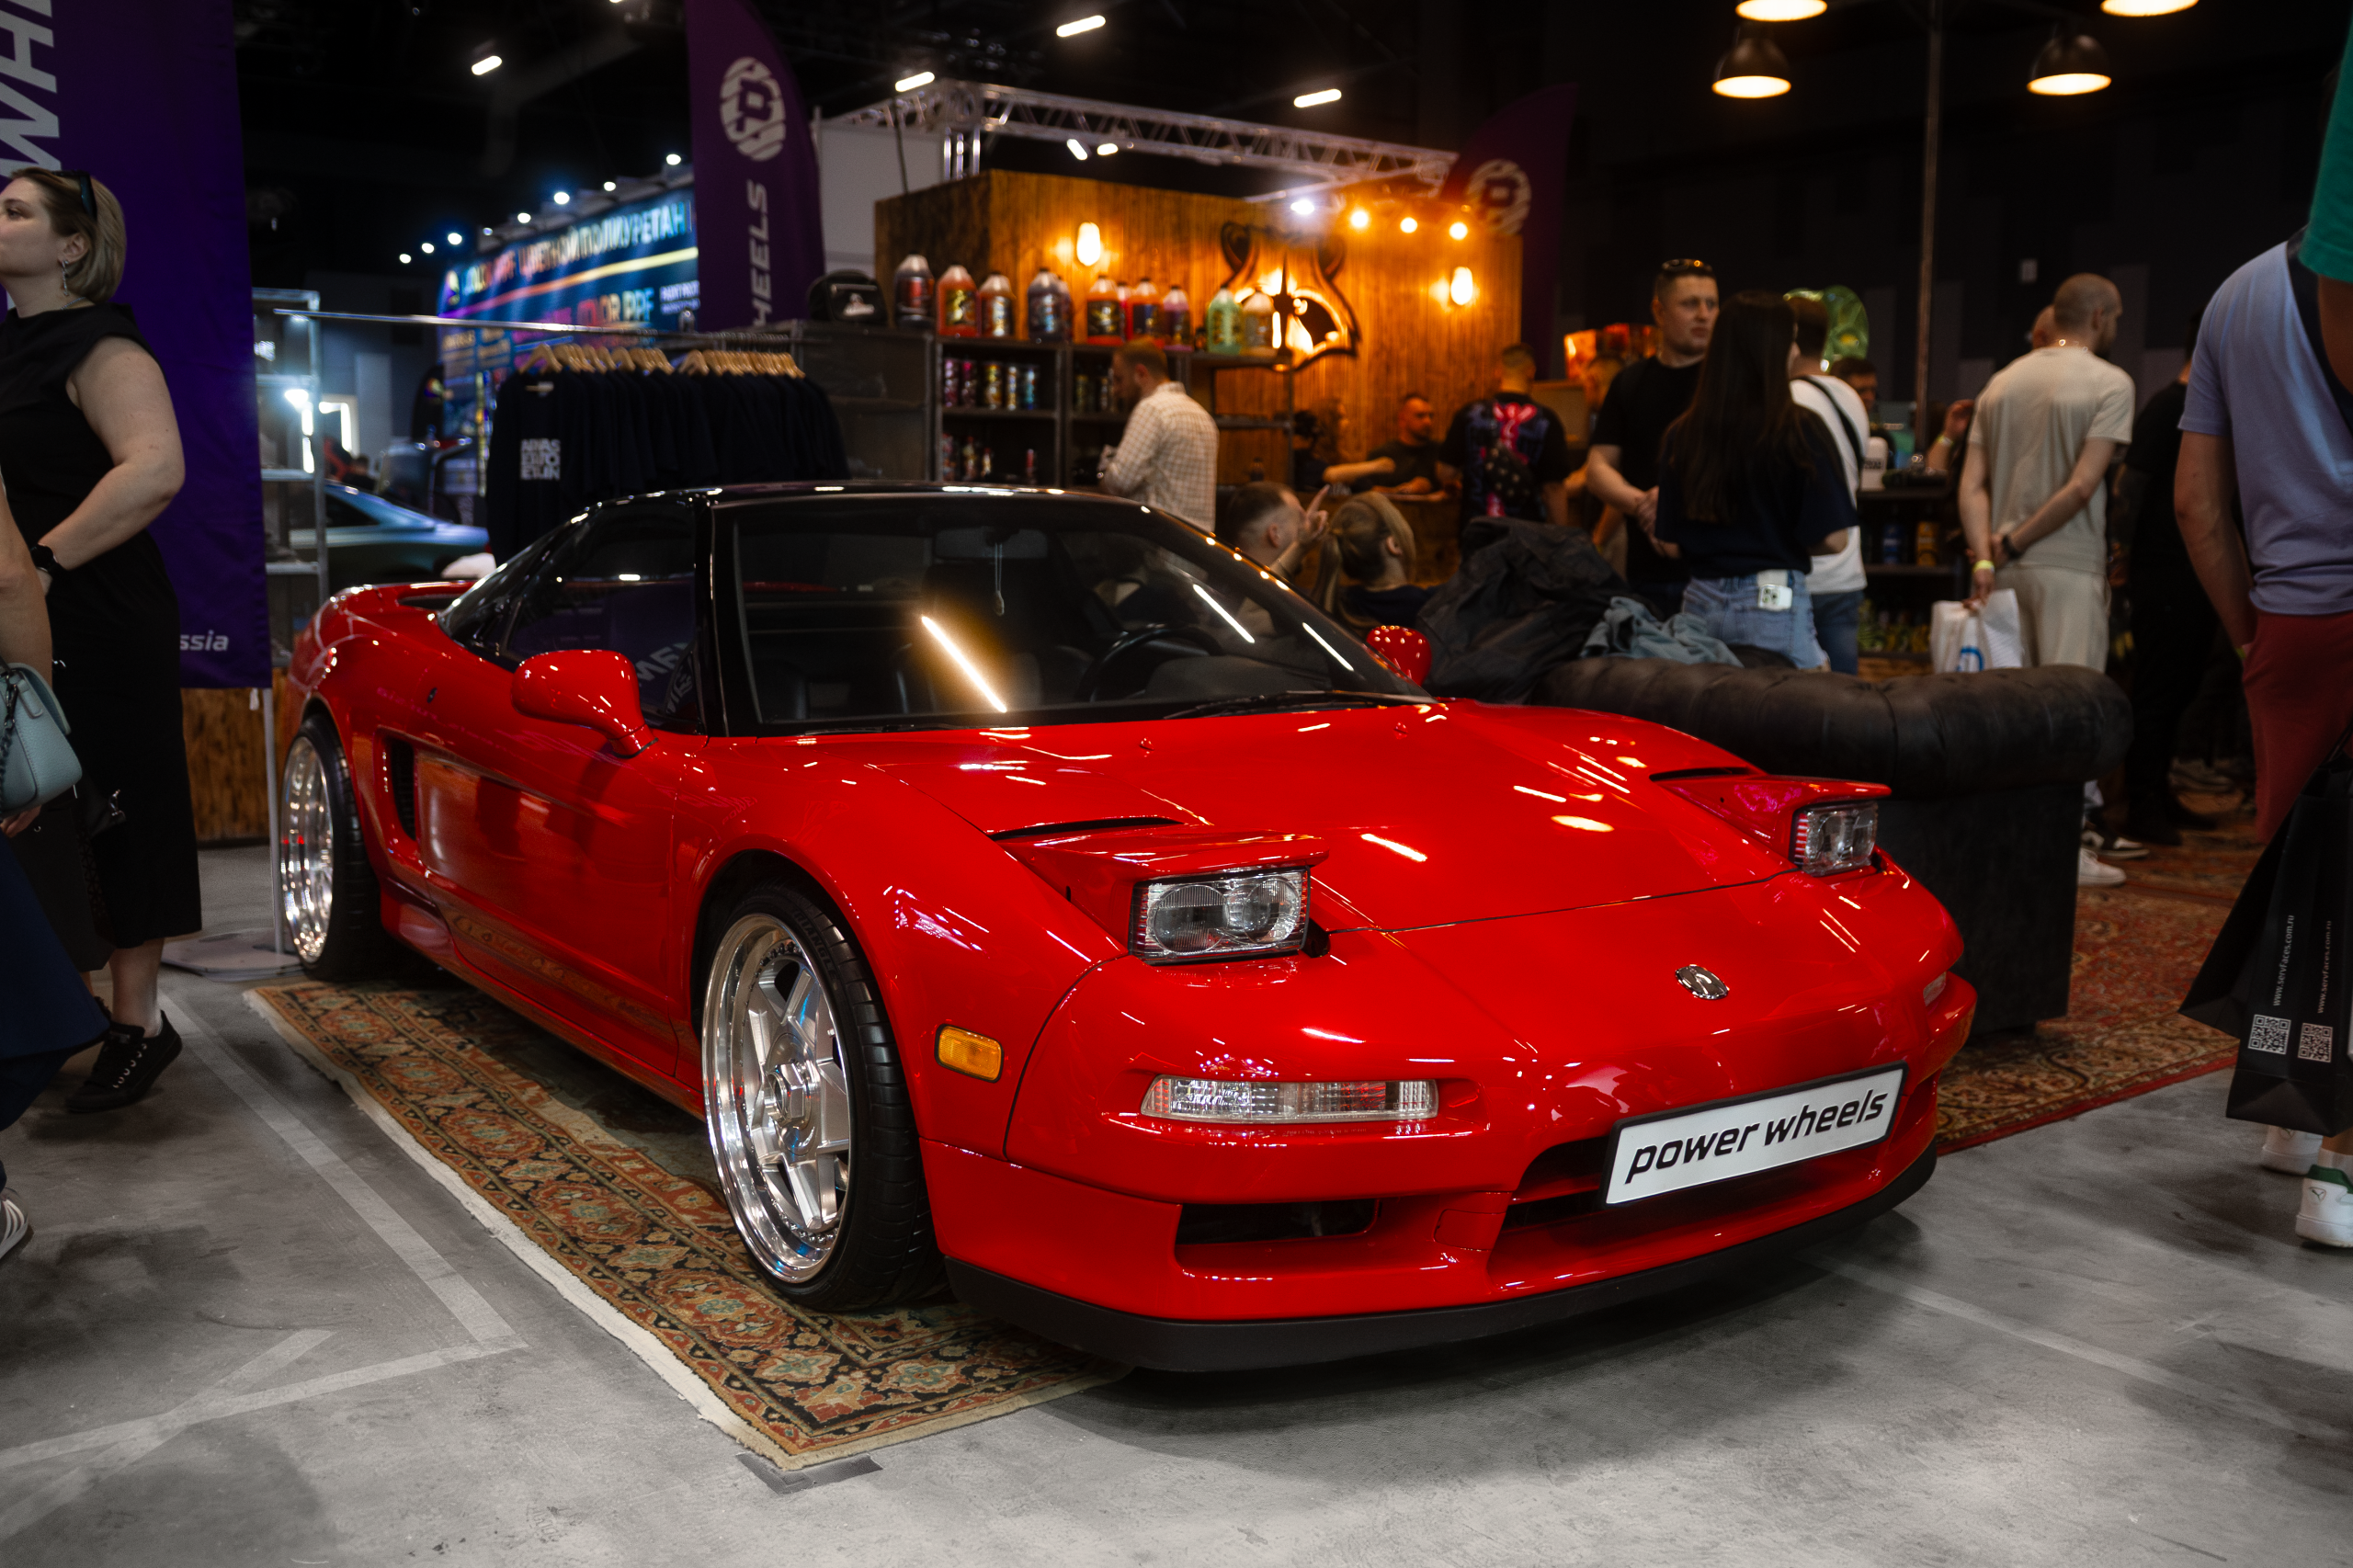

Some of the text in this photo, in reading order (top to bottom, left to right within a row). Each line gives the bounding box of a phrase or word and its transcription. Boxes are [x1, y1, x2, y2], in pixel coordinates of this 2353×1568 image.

[0, 0, 62, 175] WH
[579, 201, 686, 258] ПОЛИУРЕТАН
[1625, 1089, 1888, 1184] power wheels
